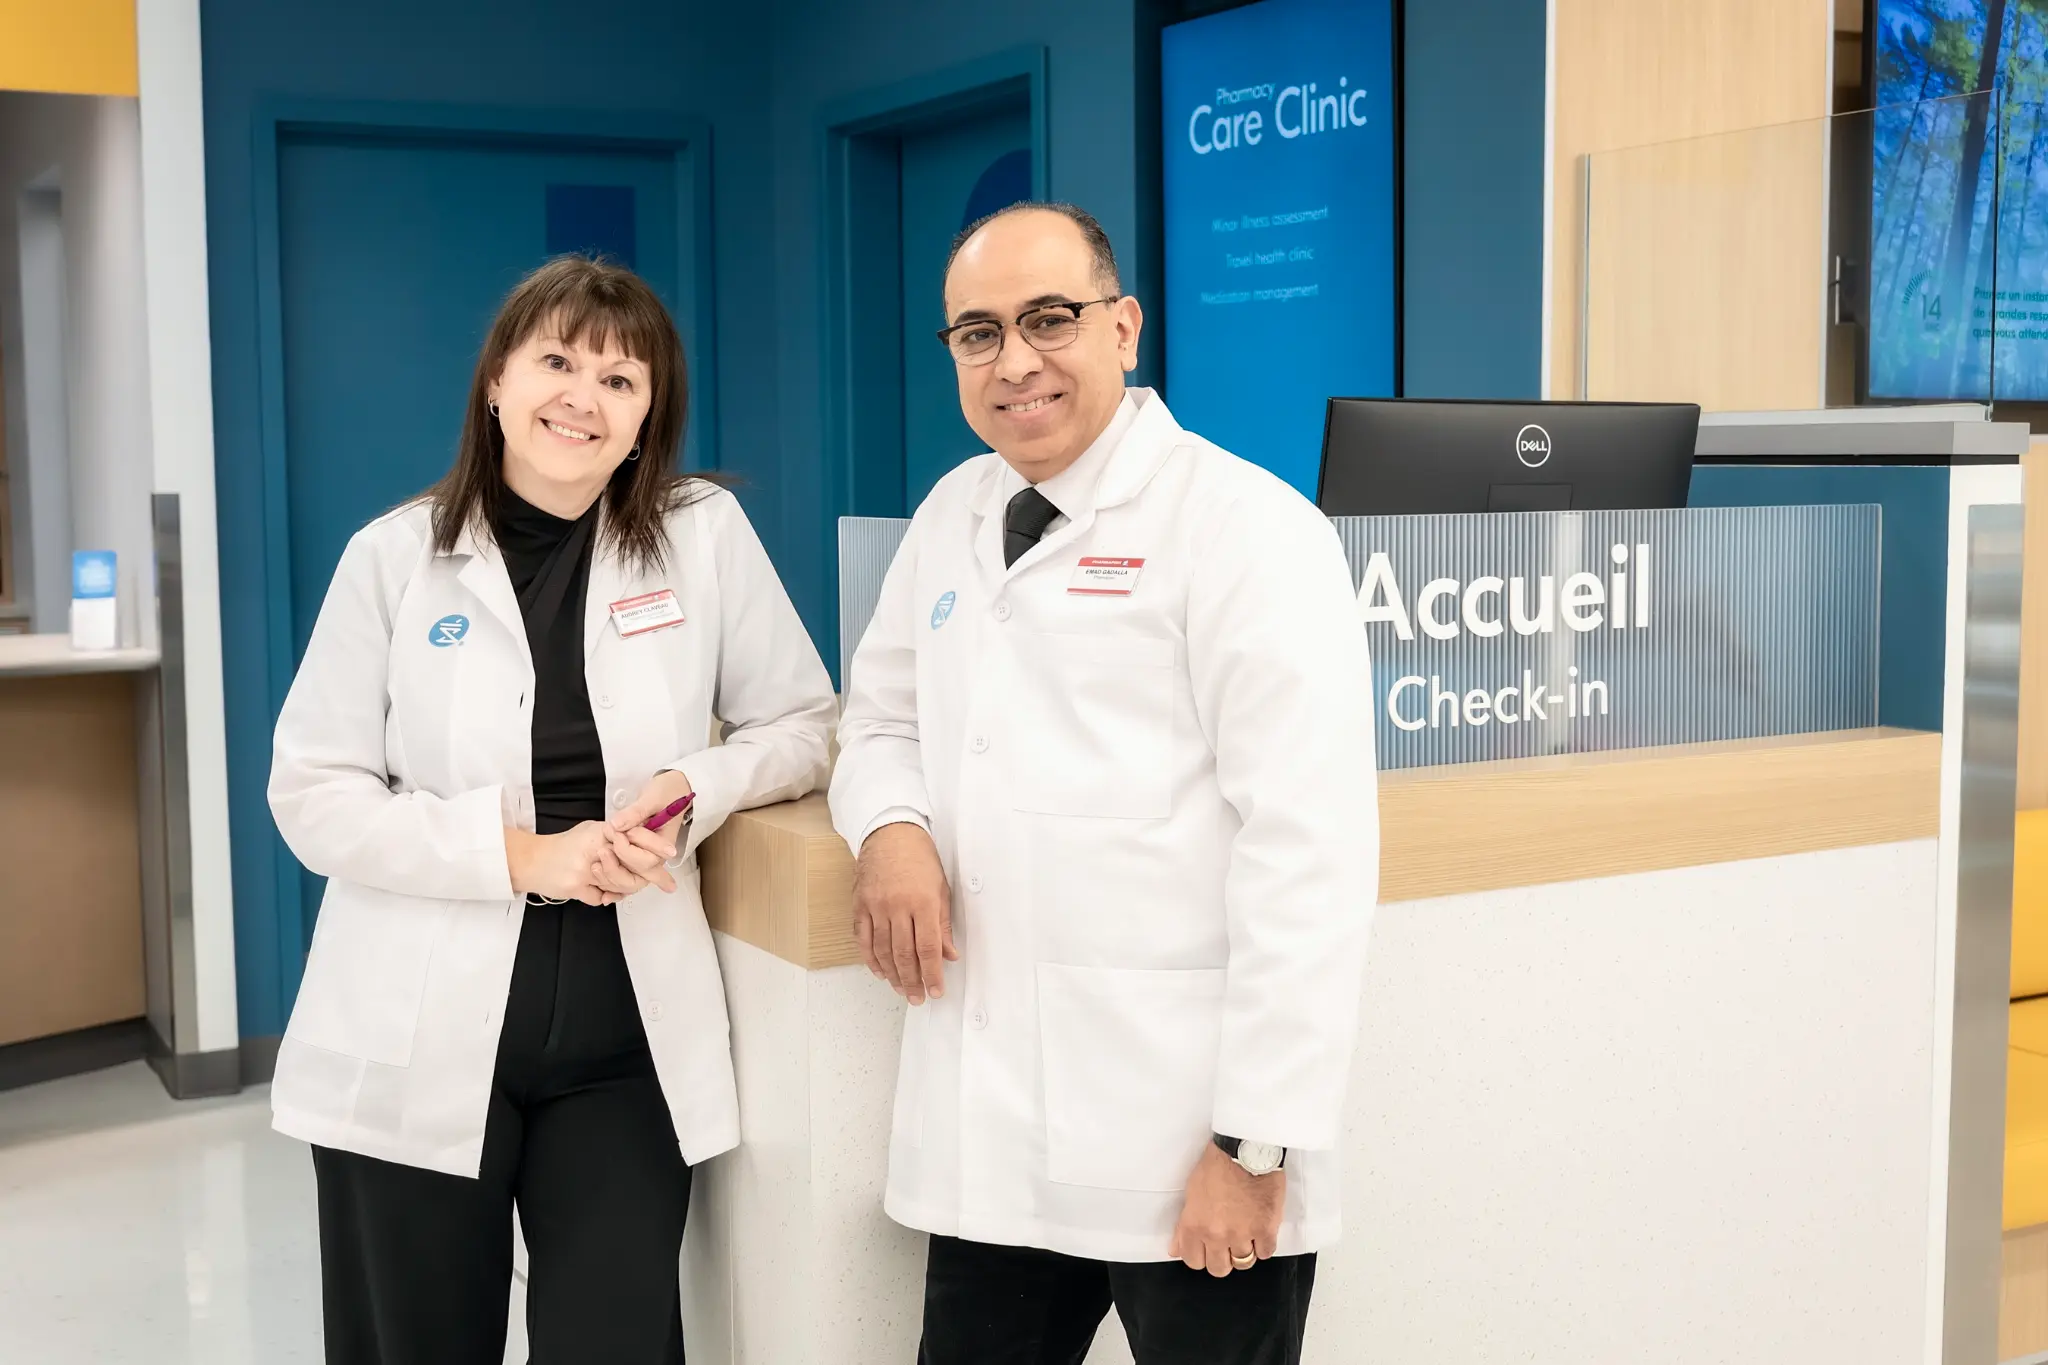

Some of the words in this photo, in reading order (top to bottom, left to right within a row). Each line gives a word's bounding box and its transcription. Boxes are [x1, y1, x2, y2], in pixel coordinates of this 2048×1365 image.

[1216, 83, 1276, 106] Pharmacy
[1189, 105, 1263, 155] Care
[1275, 76, 1368, 139] Clinic
[1271, 204, 1328, 226] assessment
[1288, 246, 1314, 262] clinic
[1922, 294, 1942, 320] 14
[1520, 440, 1548, 451] DELL
[1357, 543, 1650, 640] Accueil
[1388, 666, 1609, 731] Check-in
